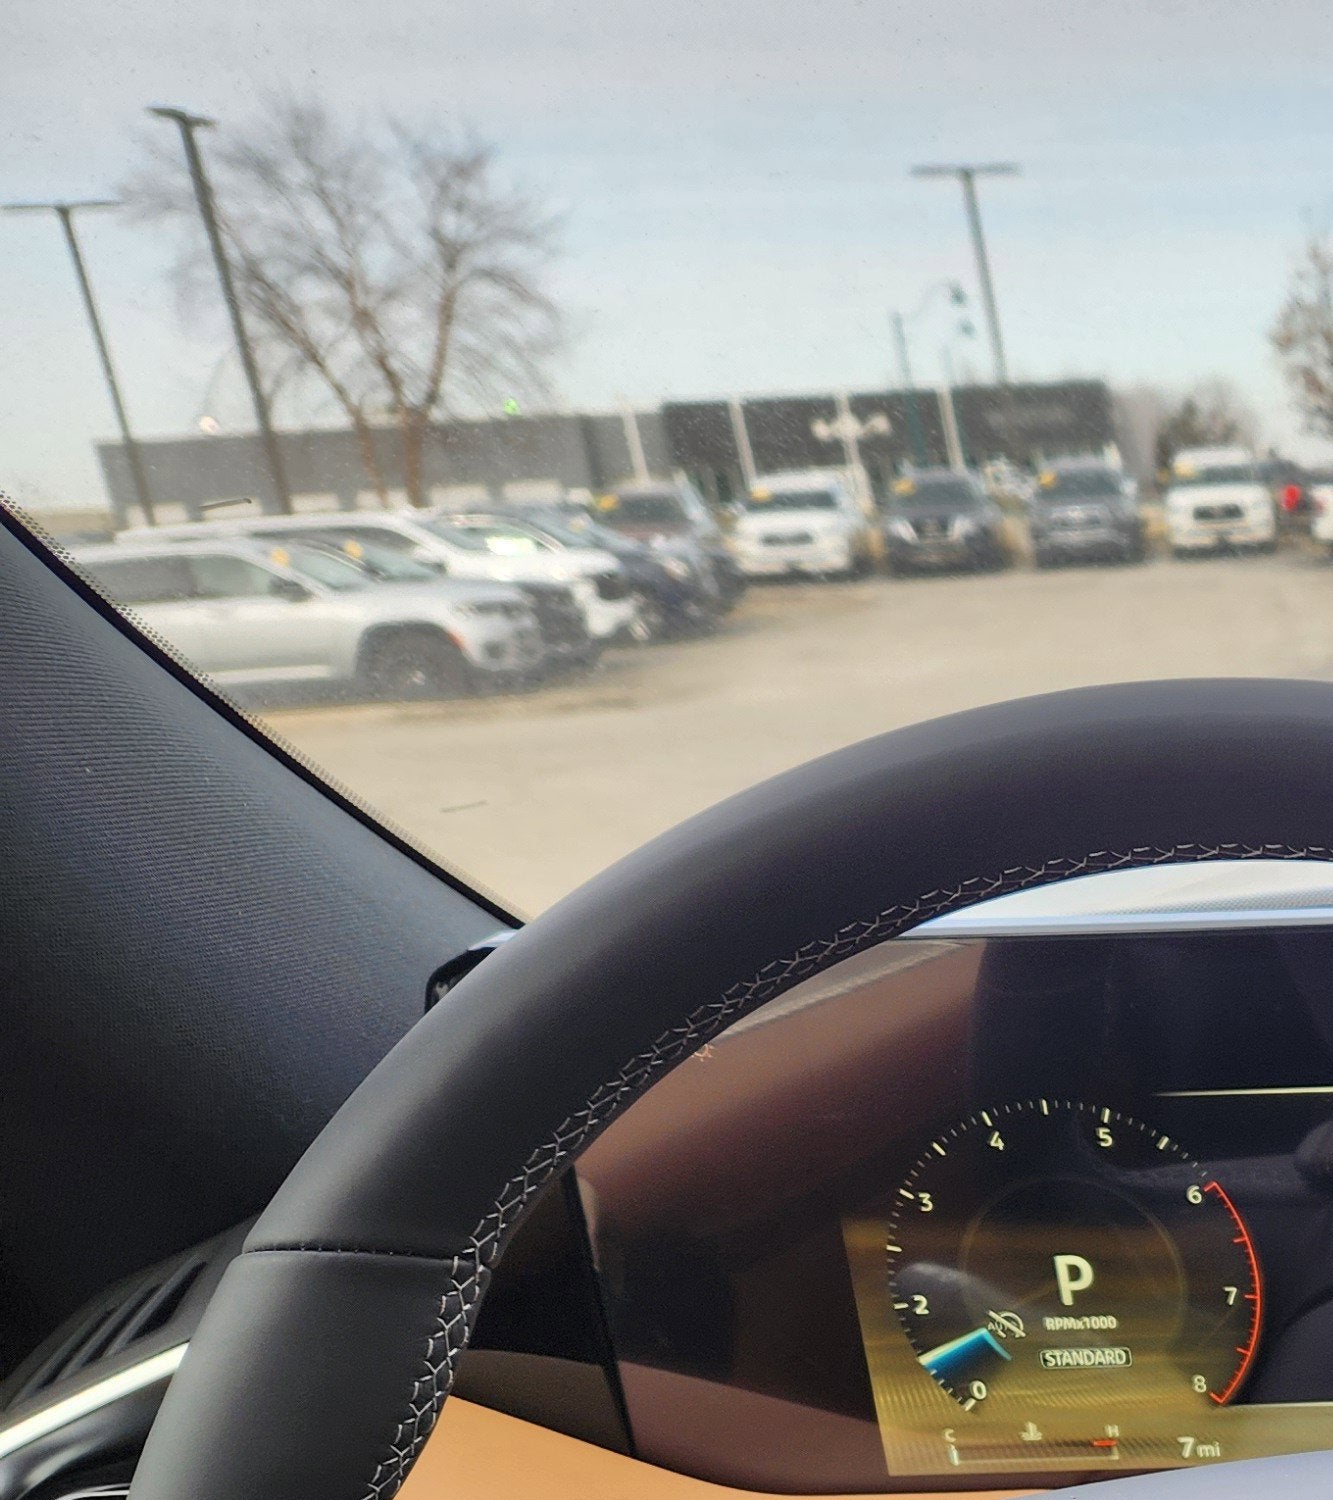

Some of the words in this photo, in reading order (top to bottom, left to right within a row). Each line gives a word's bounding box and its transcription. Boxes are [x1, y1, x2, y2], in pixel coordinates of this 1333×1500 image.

[988, 1131, 1005, 1153] 4
[1097, 1128, 1113, 1148] 5
[918, 1193, 934, 1213] 3
[1186, 1185, 1203, 1205] 6
[1053, 1255, 1095, 1306] P
[913, 1296, 930, 1316] 2
[1223, 1287, 1238, 1306] 7
[1043, 1315, 1117, 1332] RPMx1000
[1045, 1350, 1126, 1367] STANDARD
[970, 1381, 987, 1400] 0
[1192, 1375, 1207, 1393] 8
[1177, 1436, 1195, 1459] 7
[1196, 1441, 1221, 1458] mi
